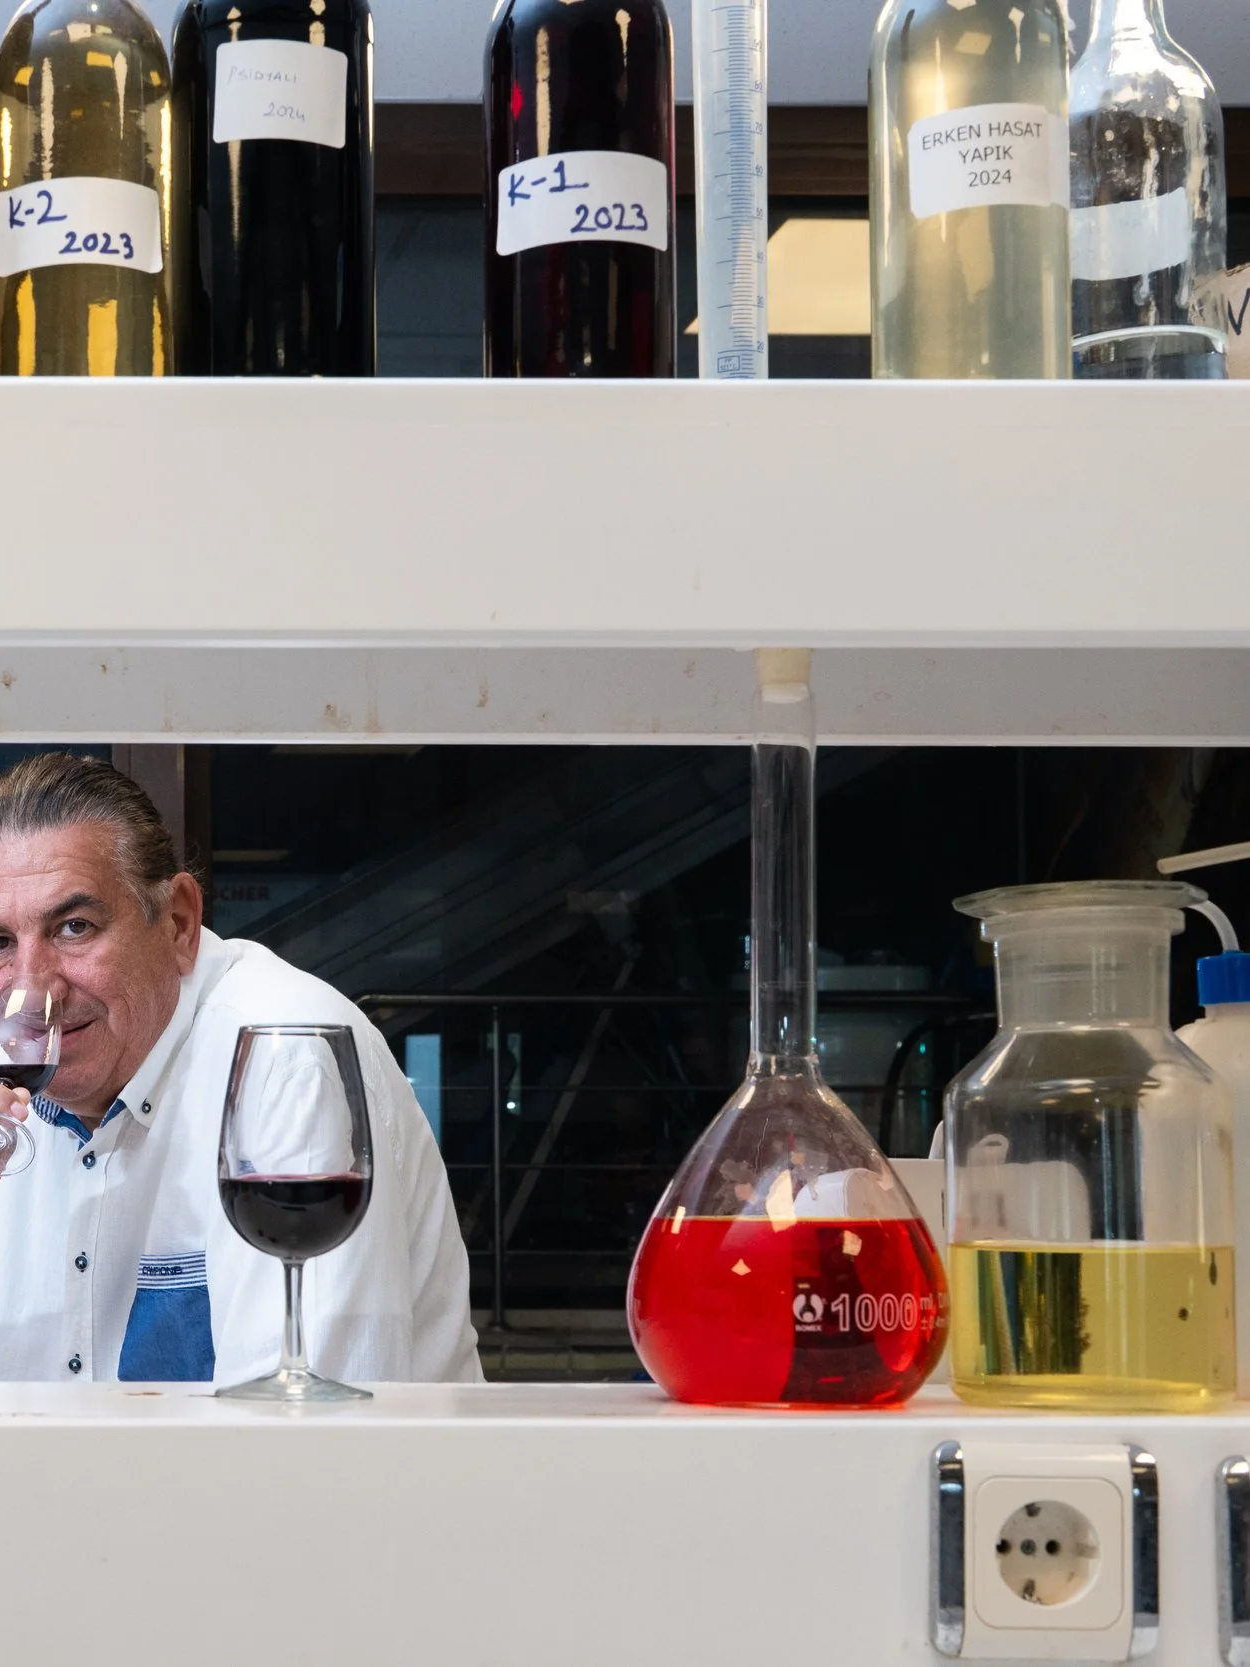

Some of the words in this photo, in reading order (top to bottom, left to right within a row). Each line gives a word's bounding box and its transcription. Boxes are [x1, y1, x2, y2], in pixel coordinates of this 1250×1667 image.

[263, 101, 305, 123] 2024
[922, 123, 981, 151] ERKEN
[988, 121, 1042, 138] HASAT
[958, 145, 1014, 164] YAPIK
[508, 160, 589, 207] K-1
[968, 169, 1013, 188] 2024
[8, 189, 68, 229] K-2
[570, 203, 648, 233] 2023
[58, 231, 134, 260] 2023
[830, 1293, 918, 1332] 1000
